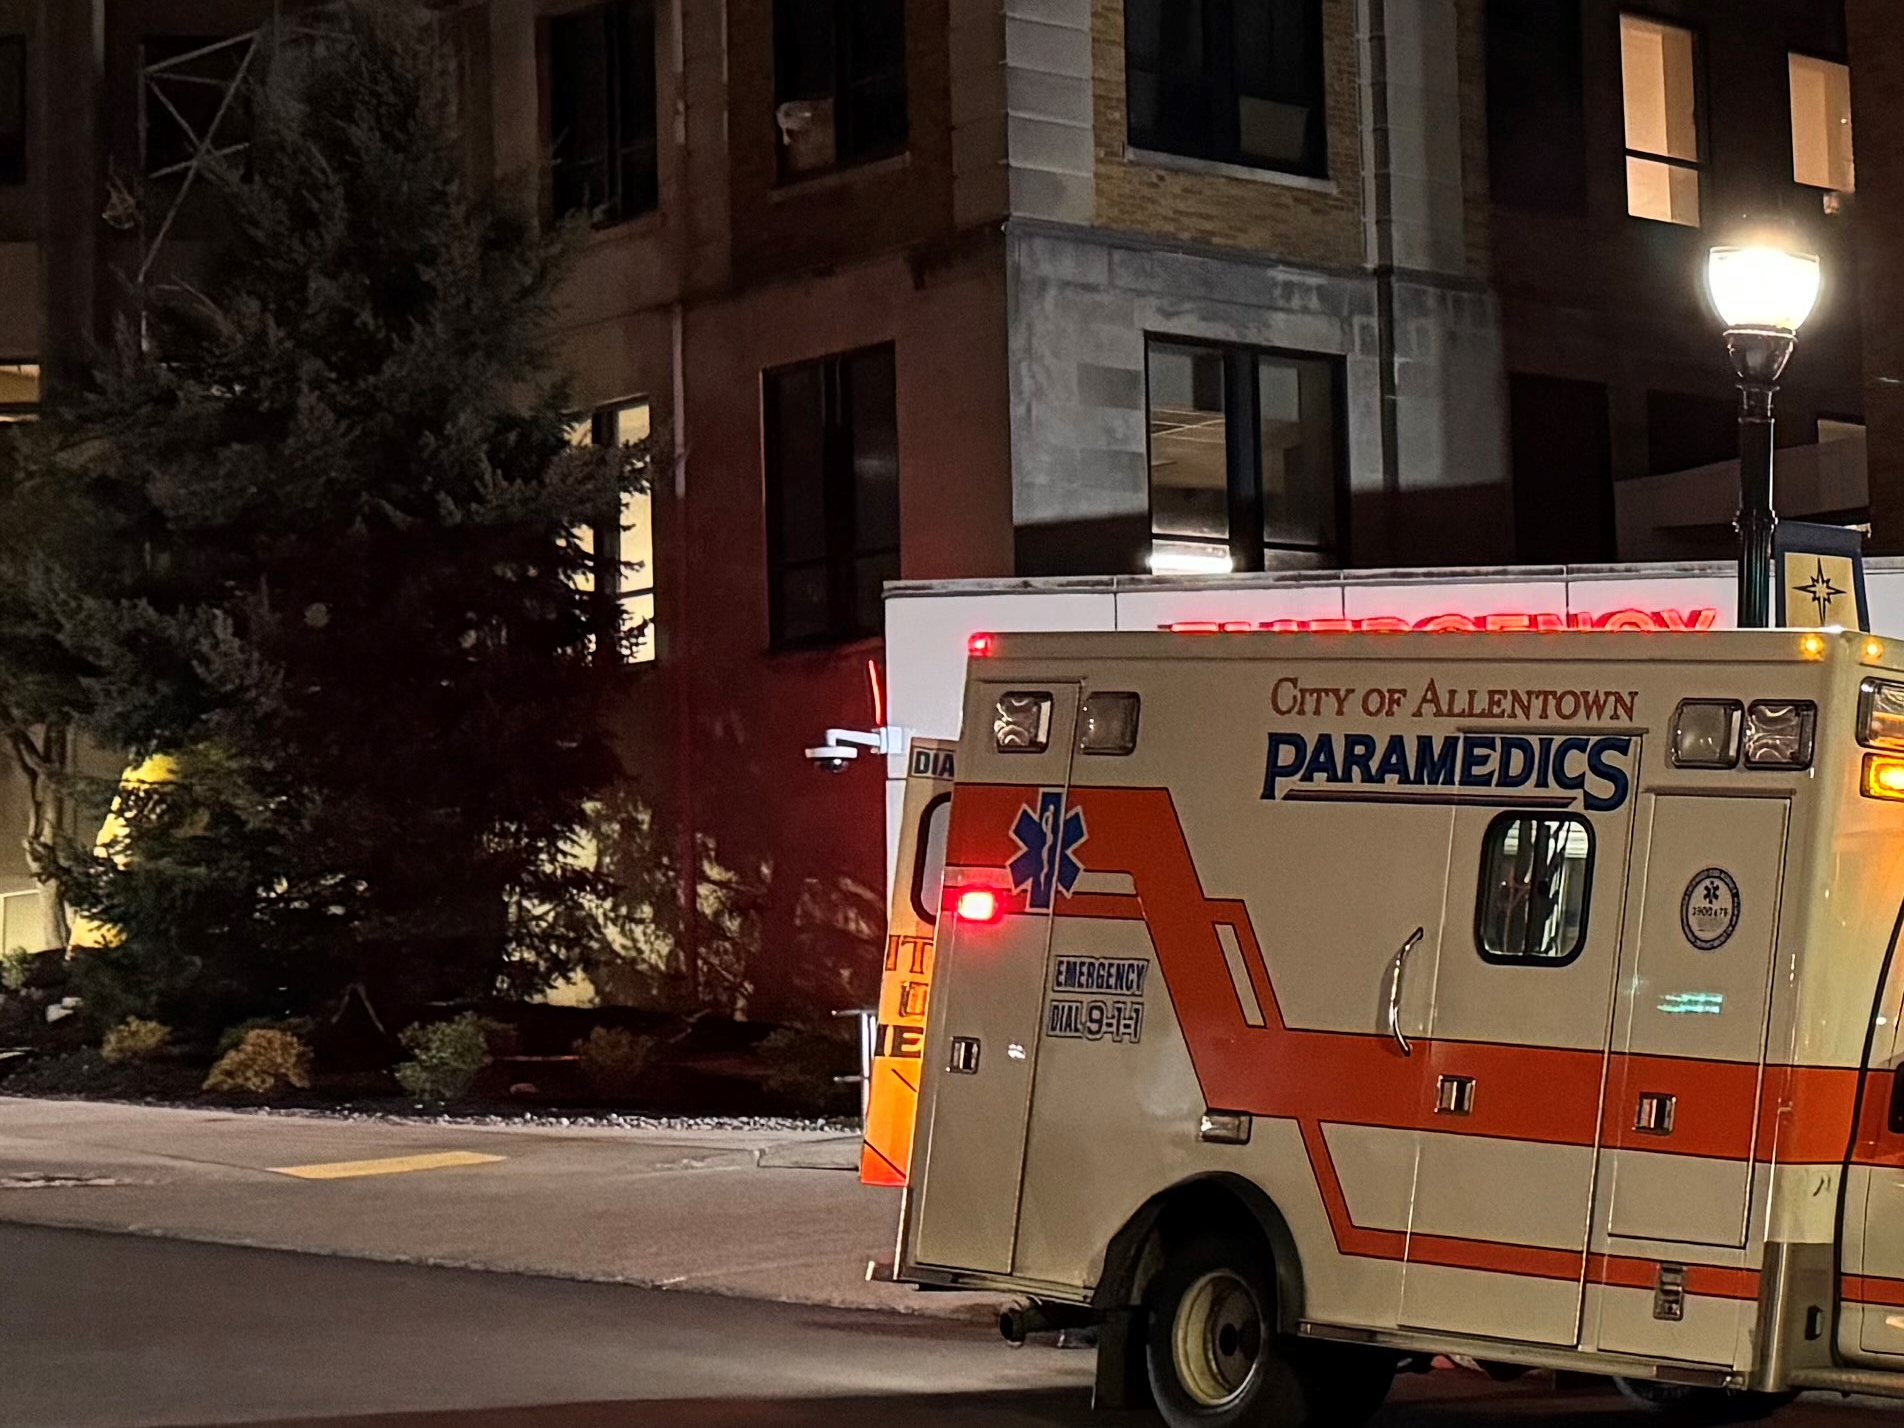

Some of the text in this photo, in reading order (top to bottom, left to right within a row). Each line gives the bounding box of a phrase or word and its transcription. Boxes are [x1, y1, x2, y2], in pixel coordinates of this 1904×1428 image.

[1270, 677, 1639, 722] CITY OF ALLENTOWN
[1260, 731, 1632, 812] PARAMEDICS
[1056, 960, 1145, 991] EMERGENCY
[1051, 1004, 1140, 1039] DIAL 9-1-1
